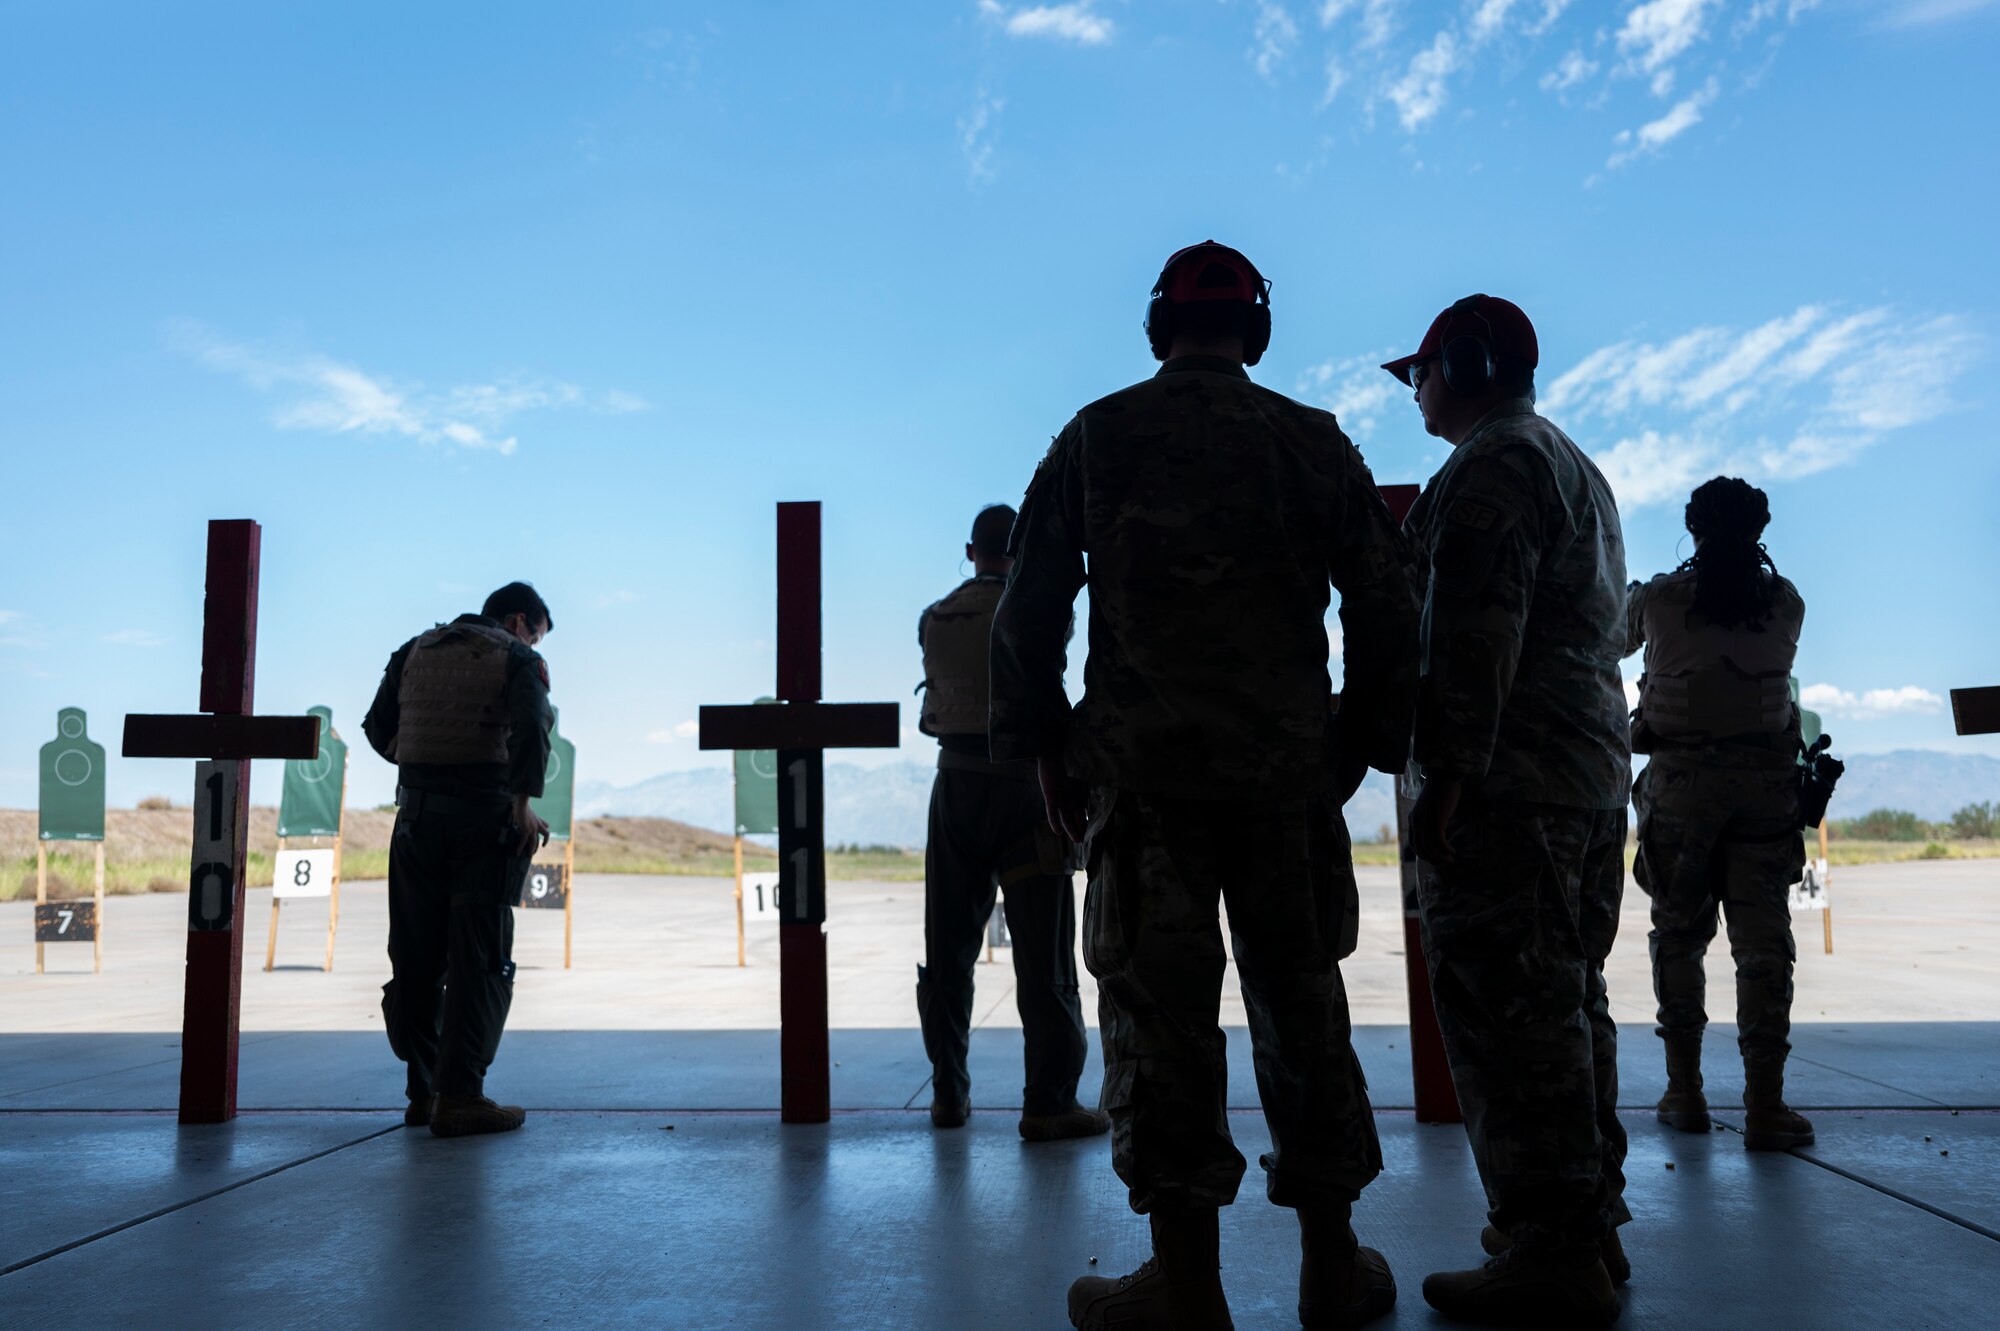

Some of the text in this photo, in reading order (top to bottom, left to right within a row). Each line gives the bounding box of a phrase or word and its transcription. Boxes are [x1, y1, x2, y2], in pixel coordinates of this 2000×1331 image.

[189, 773, 232, 931] 10
[294, 860, 311, 886] 8
[530, 874, 548, 899] 9
[58, 910, 73, 934] 7
